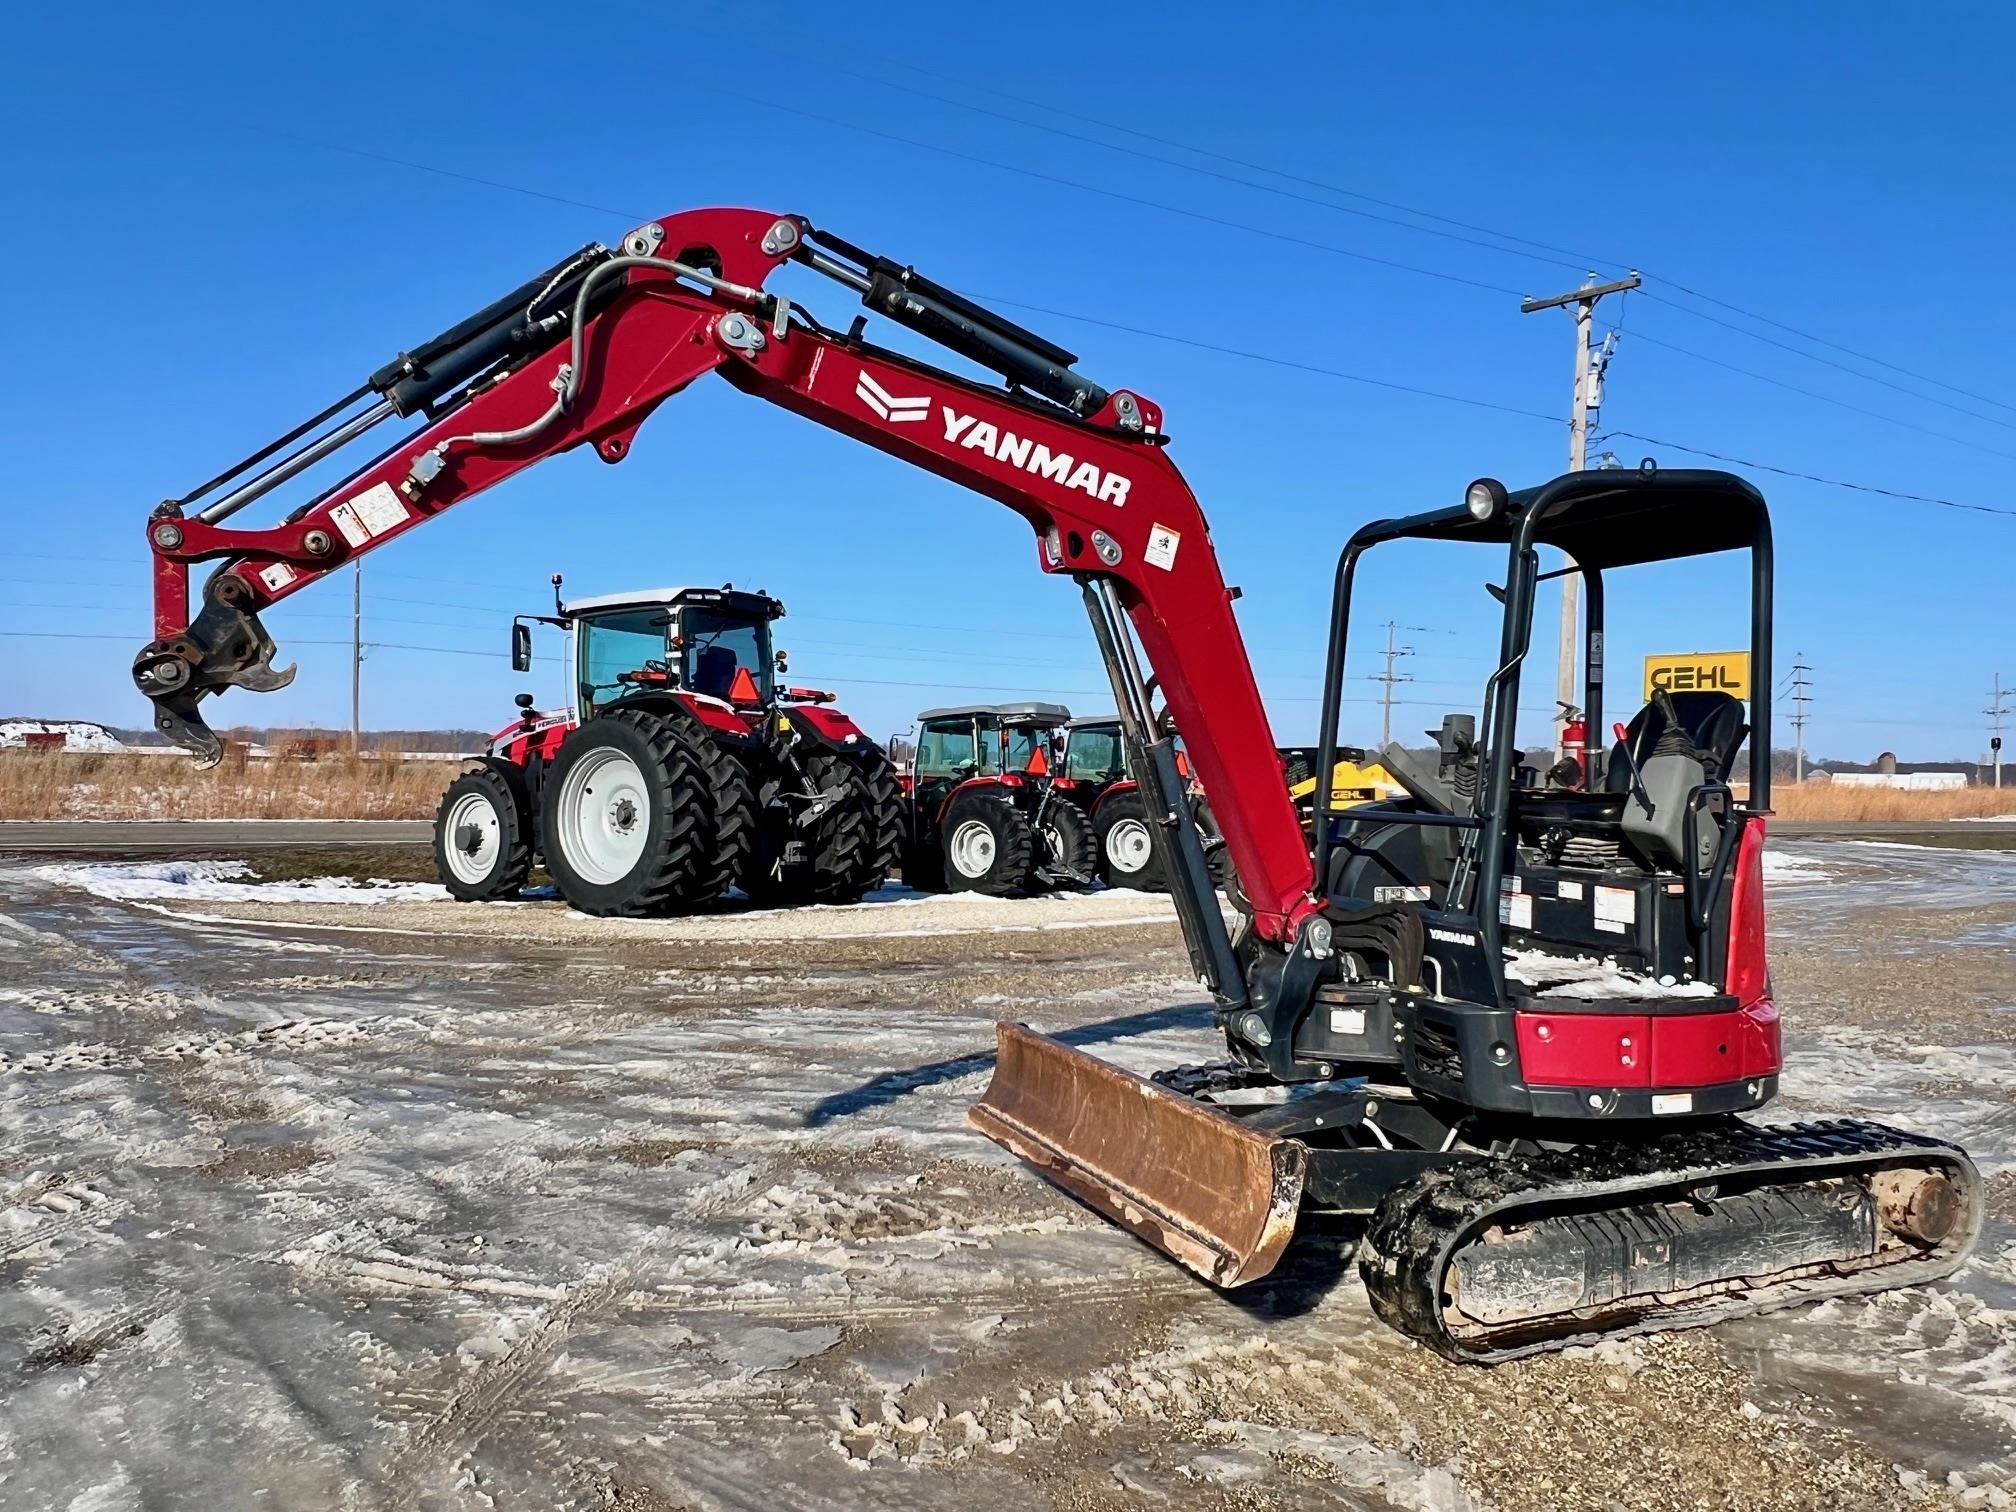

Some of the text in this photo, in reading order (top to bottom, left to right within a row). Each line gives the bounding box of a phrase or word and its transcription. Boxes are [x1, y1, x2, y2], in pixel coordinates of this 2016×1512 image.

[942, 406, 1131, 507] YANMAR
[1651, 665, 1741, 689] GEHL
[1331, 790, 1364, 799] GEHL
[1429, 928, 1475, 946] YANMAR
